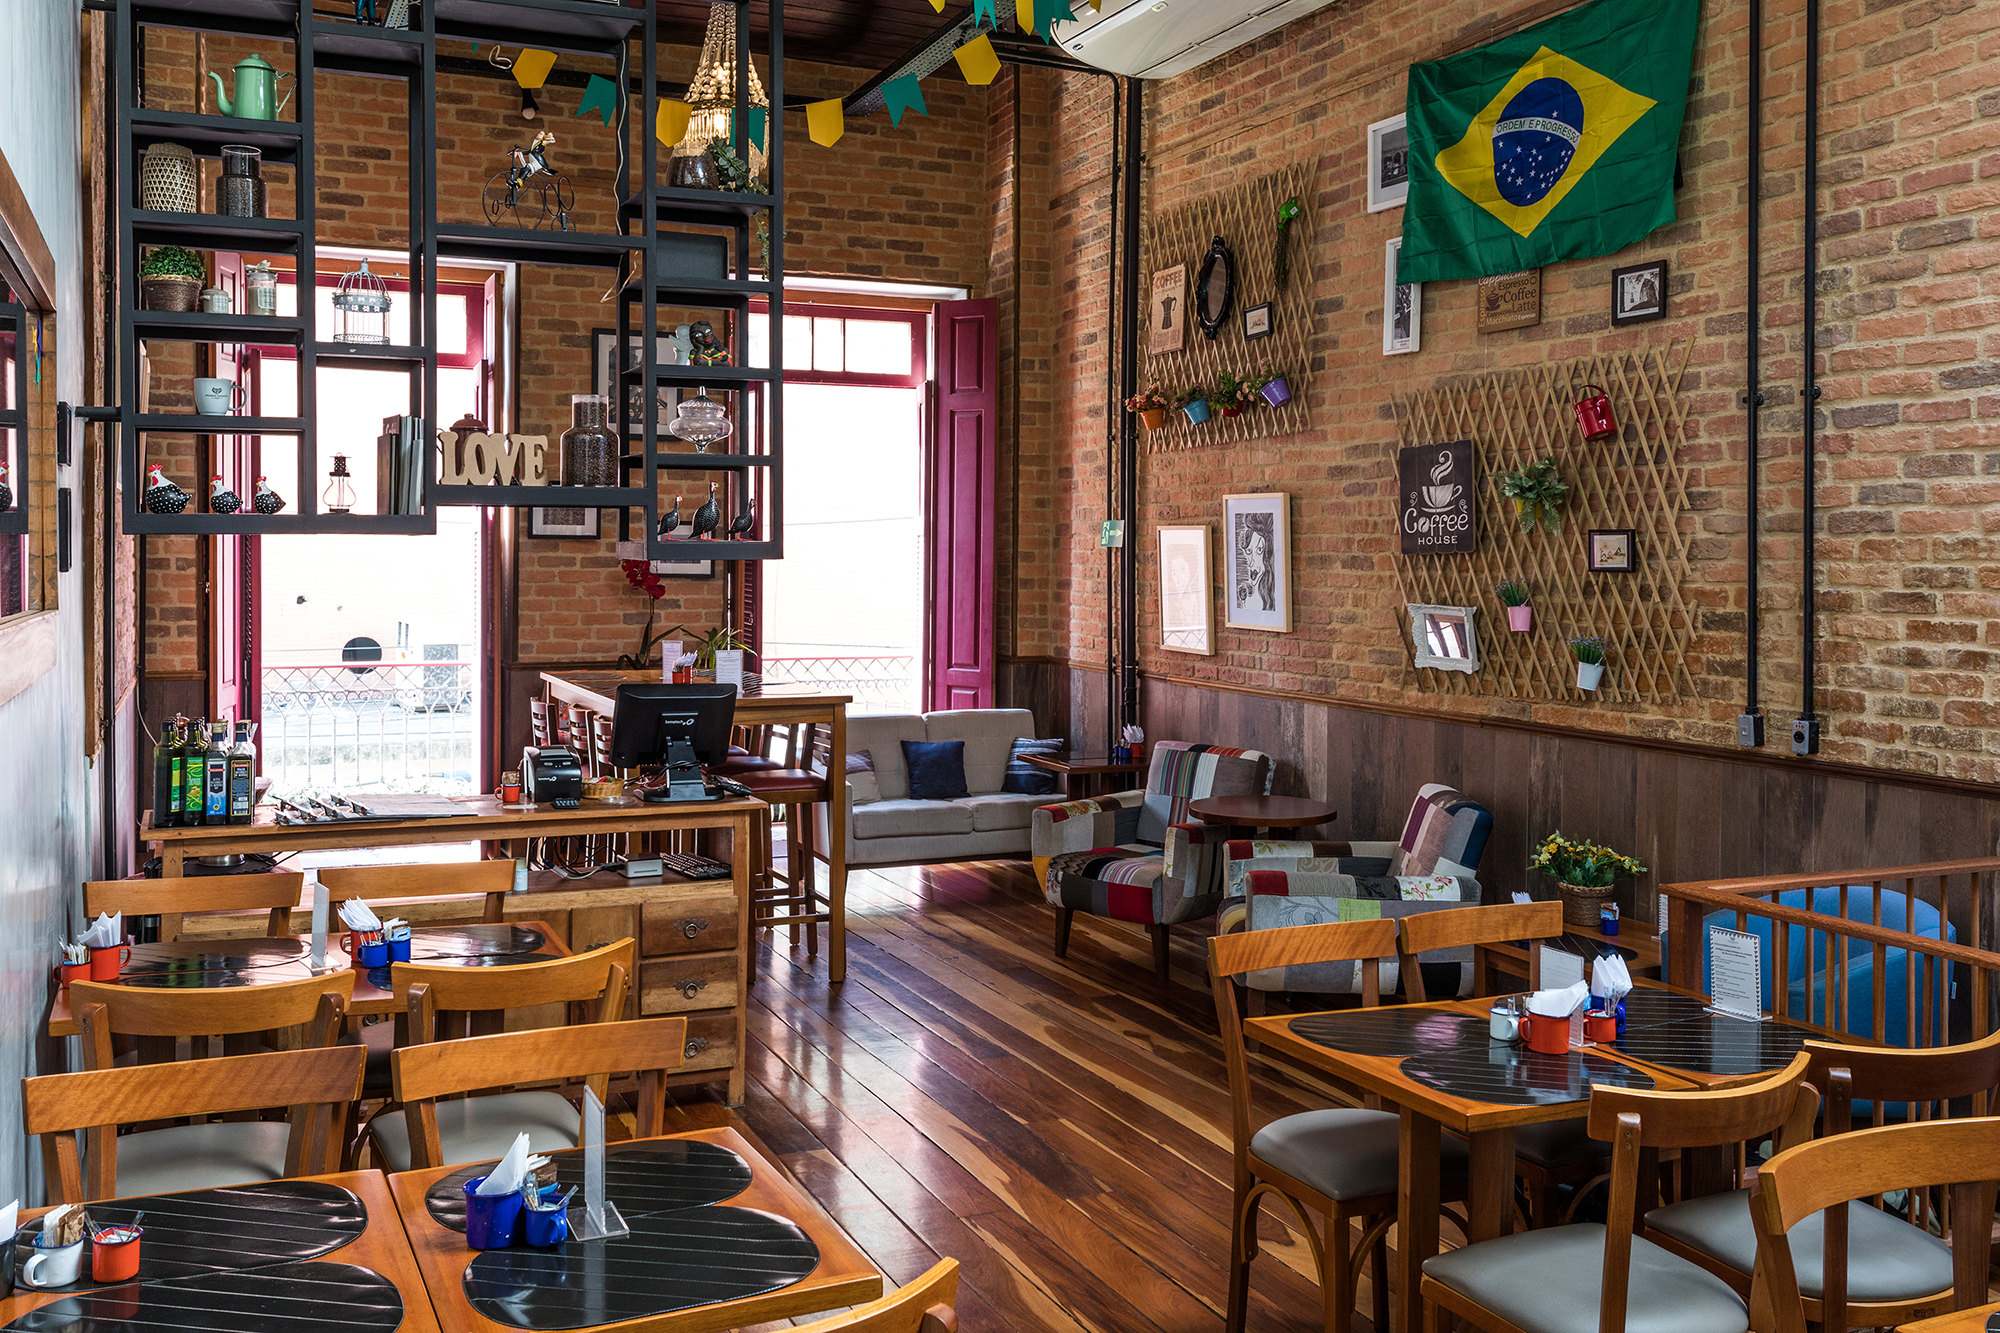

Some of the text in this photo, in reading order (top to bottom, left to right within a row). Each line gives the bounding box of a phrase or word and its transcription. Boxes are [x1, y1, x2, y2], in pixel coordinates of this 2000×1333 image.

[1496, 119, 1579, 143] ORDEM E PROGRESSO
[1155, 270, 1182, 289] COFFEE
[1498, 279, 1529, 291] Espresso
[1503, 287, 1537, 304] Coffee
[1512, 301, 1536, 313] Latte
[440, 432, 548, 486] LOVE
[1404, 508, 1468, 536] Coffee
[1418, 535, 1458, 545] HOUSE
